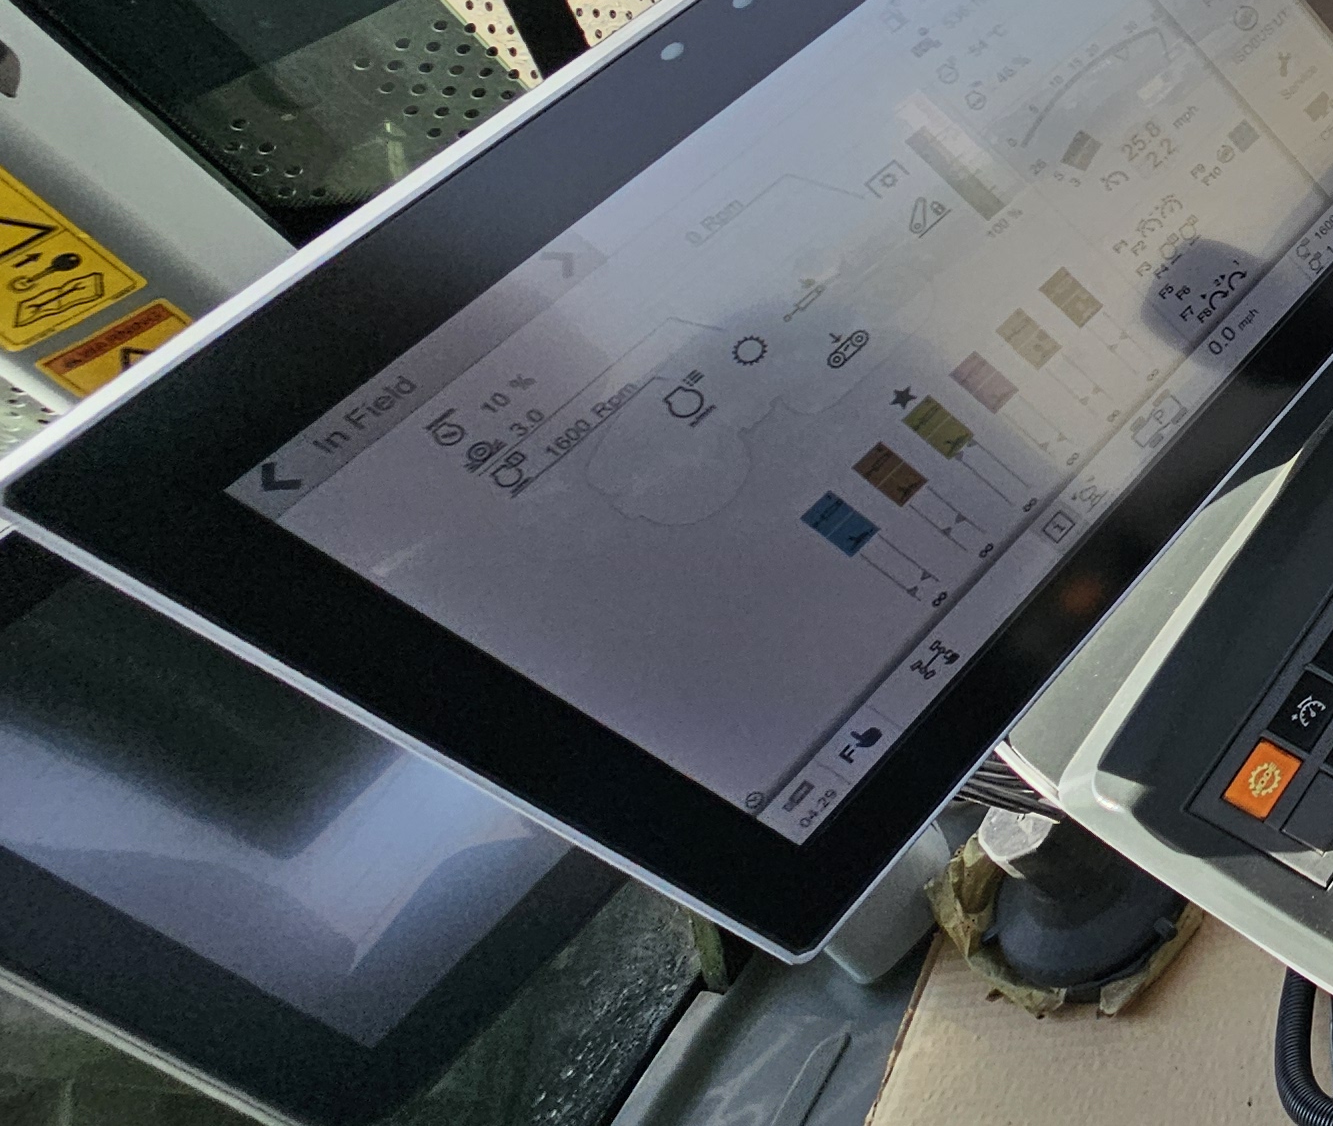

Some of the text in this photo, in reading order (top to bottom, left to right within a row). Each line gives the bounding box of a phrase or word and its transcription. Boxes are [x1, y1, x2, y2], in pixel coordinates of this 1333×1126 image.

[1278, 64, 1319, 100] Service
[1120, 103, 1200, 163] 25.8 mph
[1200, 165, 1223, 188] F10
[699, 198, 747, 232] Rpm
[1157, 281, 1176, 302] F5
[1173, 283, 1193, 302] F6
[1178, 304, 1197, 324] F7
[1206, 307, 1261, 356] 0.0 mph
[480, 373, 537, 414] 10 %
[311, 374, 418, 456] In Field
[508, 407, 546, 438] 3.0
[544, 381, 639, 459] 1600 Rpm
